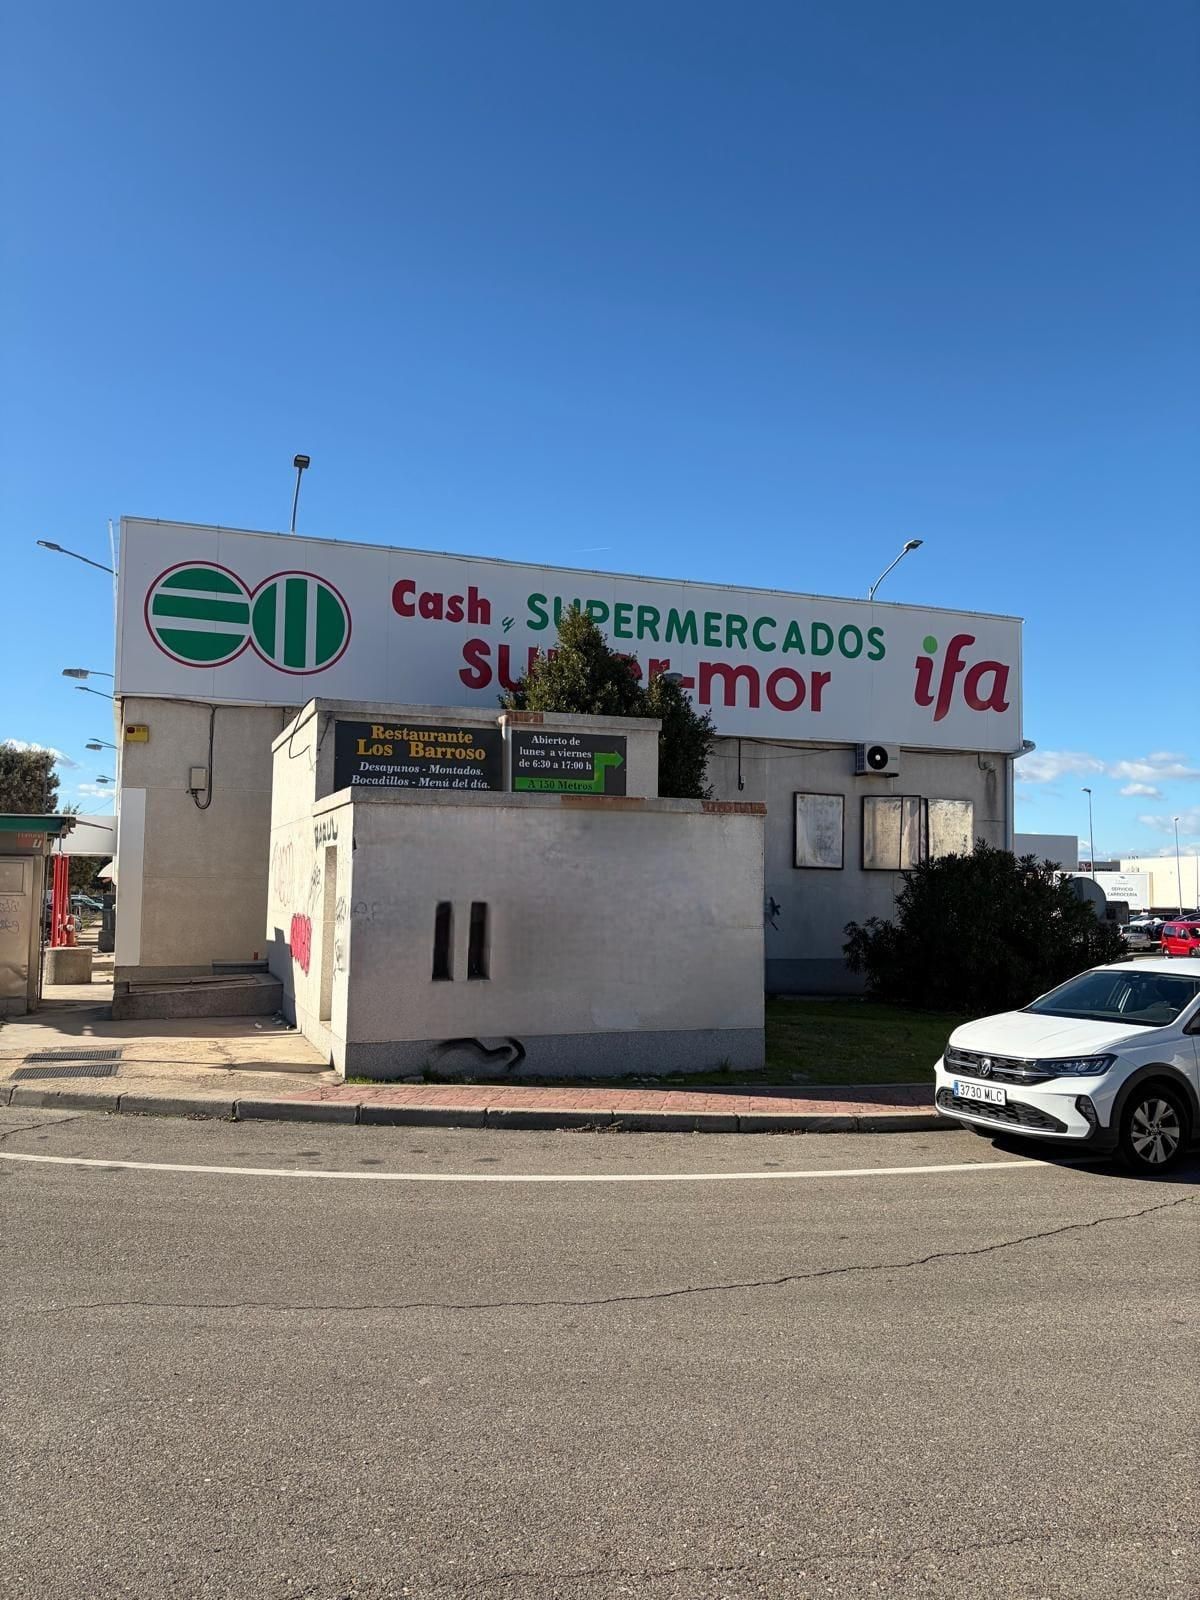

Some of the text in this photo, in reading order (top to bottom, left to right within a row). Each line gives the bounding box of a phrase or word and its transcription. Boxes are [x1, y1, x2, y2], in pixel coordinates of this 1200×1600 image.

[392, 580, 886, 662] Cash y SUPERMERCADOS
[915, 634, 1009, 721] ifa
[371, 725, 473, 744] Restaurante
[531, 735, 581, 745] Abierto de
[356, 739, 486, 760] Los Barroso
[519, 746, 545, 756] lunes
[558, 748, 592, 758] viernes
[359, 761, 420, 774] Desayunos
[428, 764, 484, 776] Montados.
[519, 759, 530, 768] de
[532, 760, 551, 769] 6:30
[562, 761, 583, 770] 17:00
[586, 762, 592, 770] h
[351, 775, 410, 786] Bocadillos
[418, 777, 450, 787] Menú
[452, 779, 468, 788] del
[470, 780, 491, 789] día.
[527, 779, 593, 791] A 150 Metros
[960, 1084, 1002, 1103] 3730 MLC
